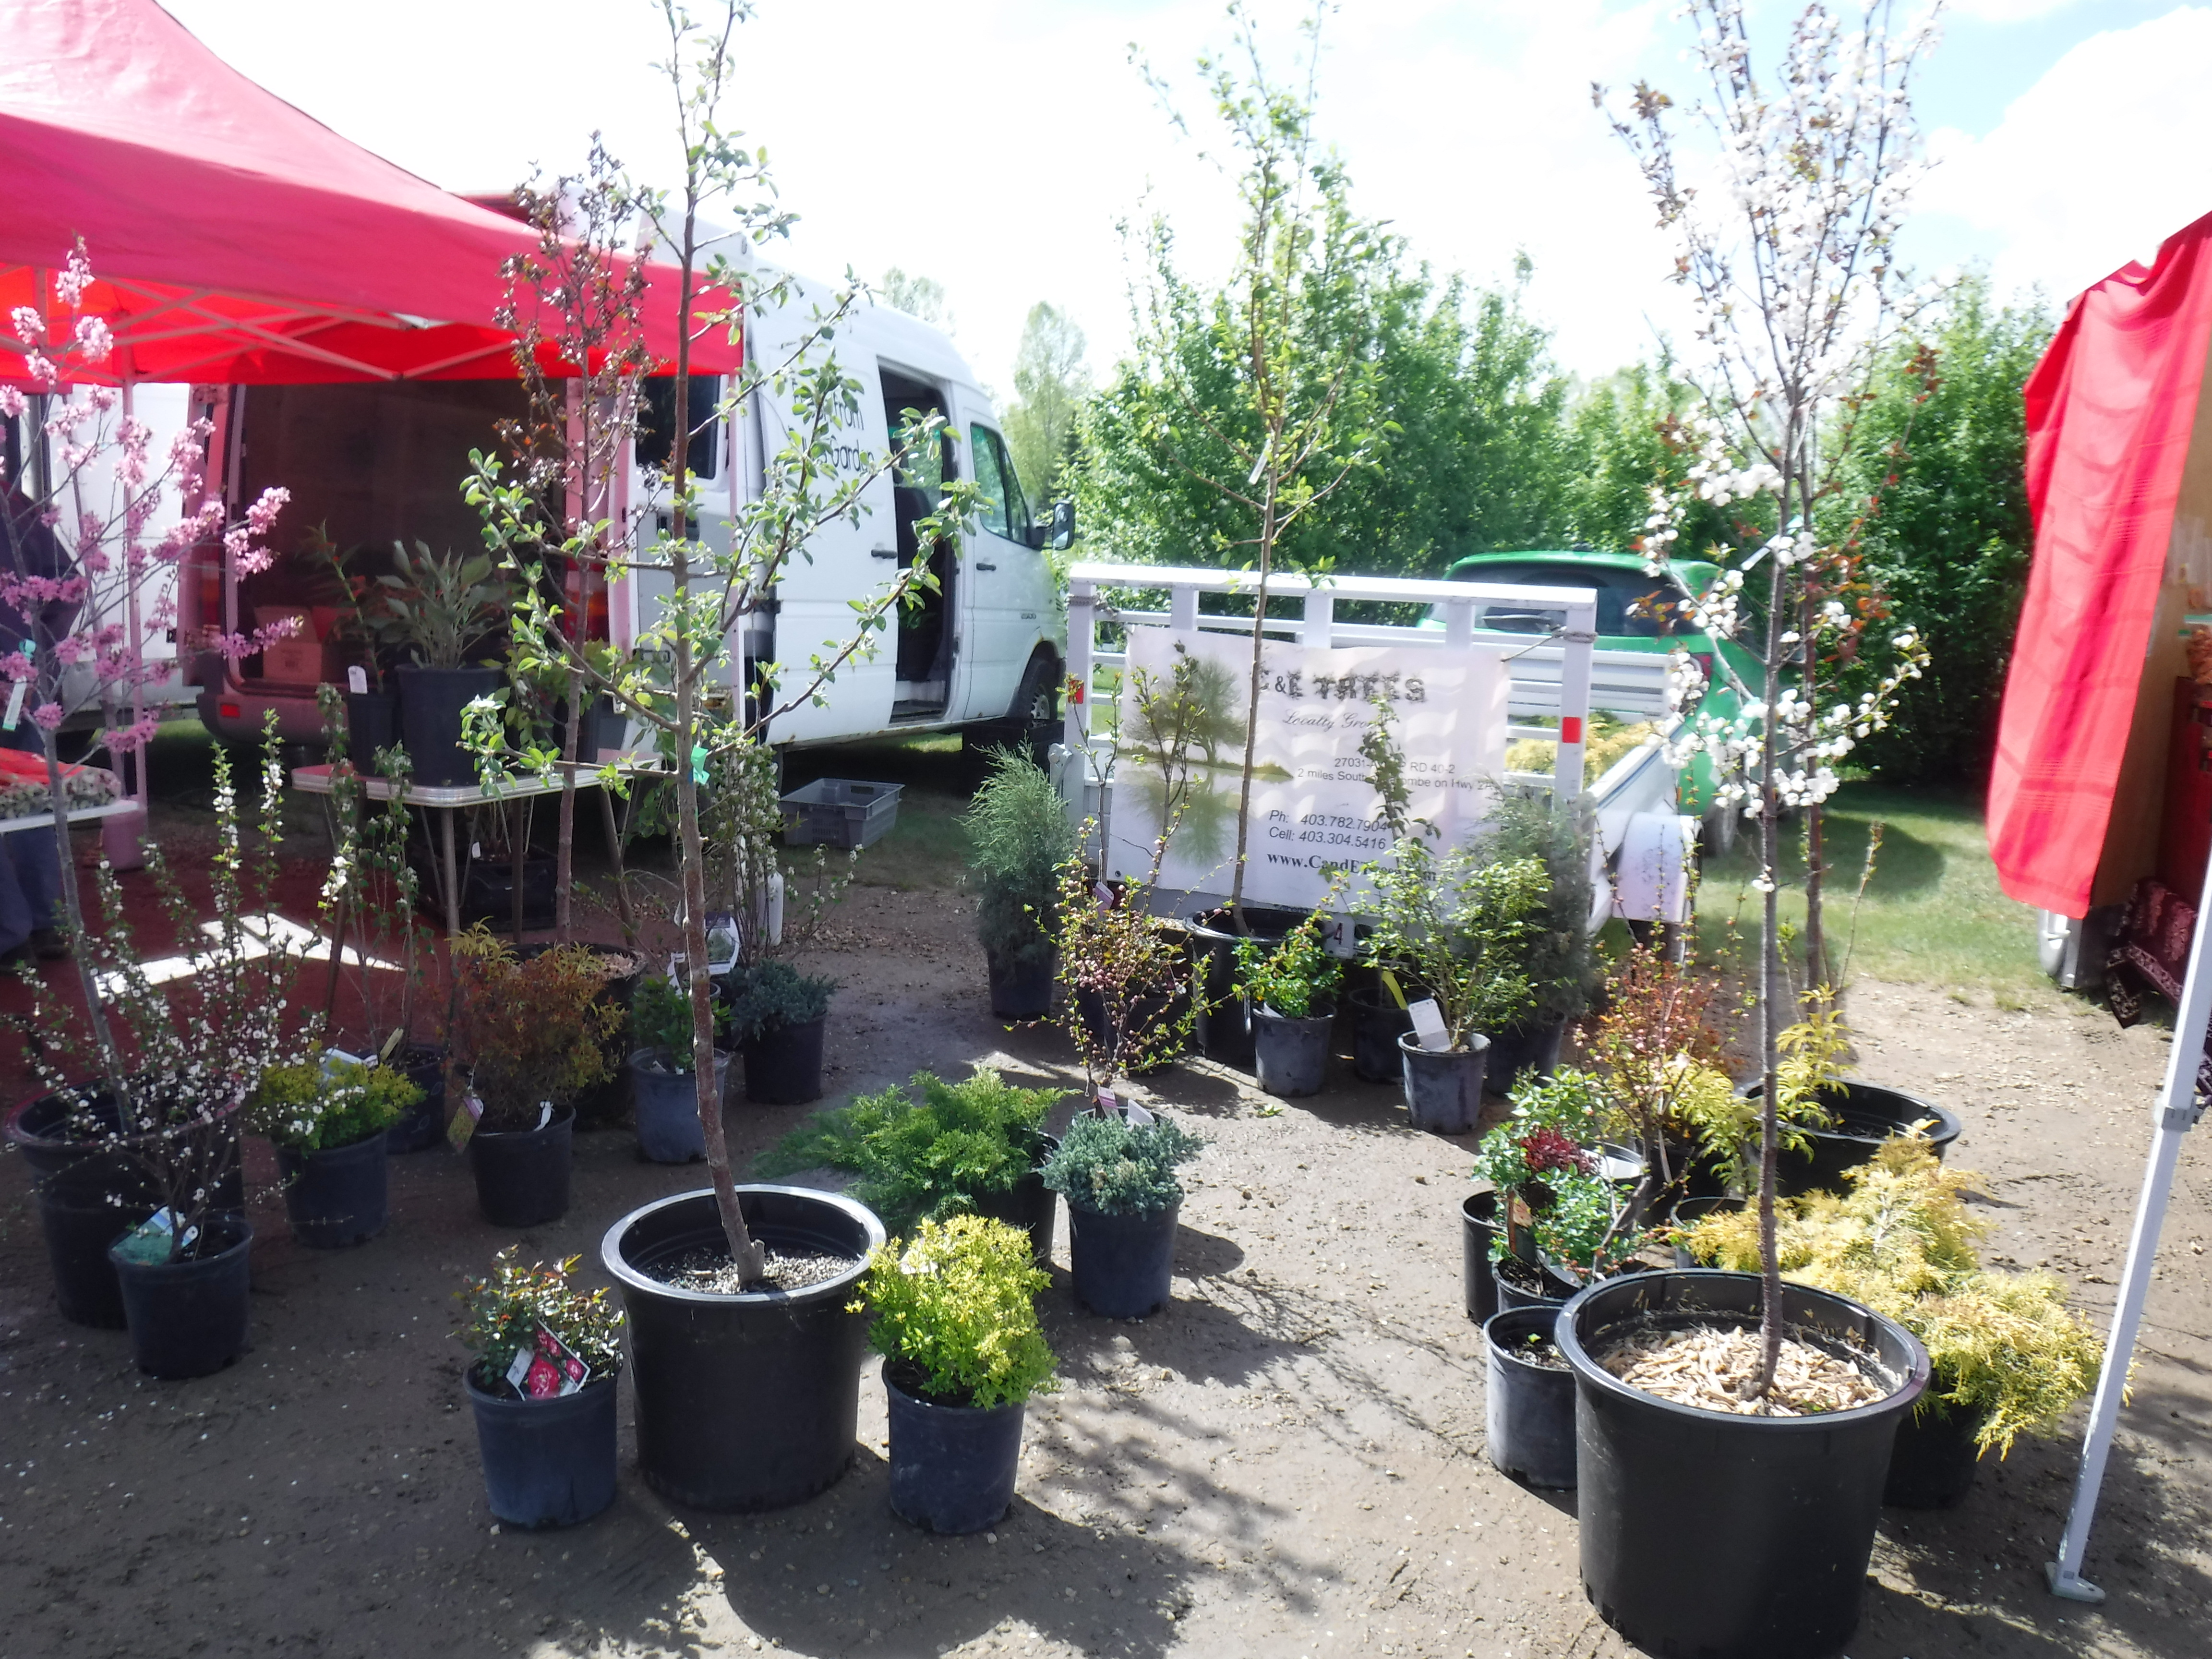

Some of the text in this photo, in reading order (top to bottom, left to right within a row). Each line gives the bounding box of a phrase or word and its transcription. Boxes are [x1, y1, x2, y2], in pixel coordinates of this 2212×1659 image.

[829, 434, 876, 476] Gardn
[1313, 670, 1427, 702] TREES
[1283, 709, 1368, 732] Locally Gro
[1334, 757, 1374, 768] 27031-
[1410, 762, 1428, 772] RD
[1431, 764, 1456, 774] 40-2
[1298, 768, 1304, 778] 2
[1308, 769, 1334, 781] miles
[1434, 779, 1447, 788] on
[1452, 778, 1472, 790] Hwy
[1269, 809, 1388, 832] Ph: 403.782.7904
[1269, 826, 1386, 849] Cell: 403.304.5416
